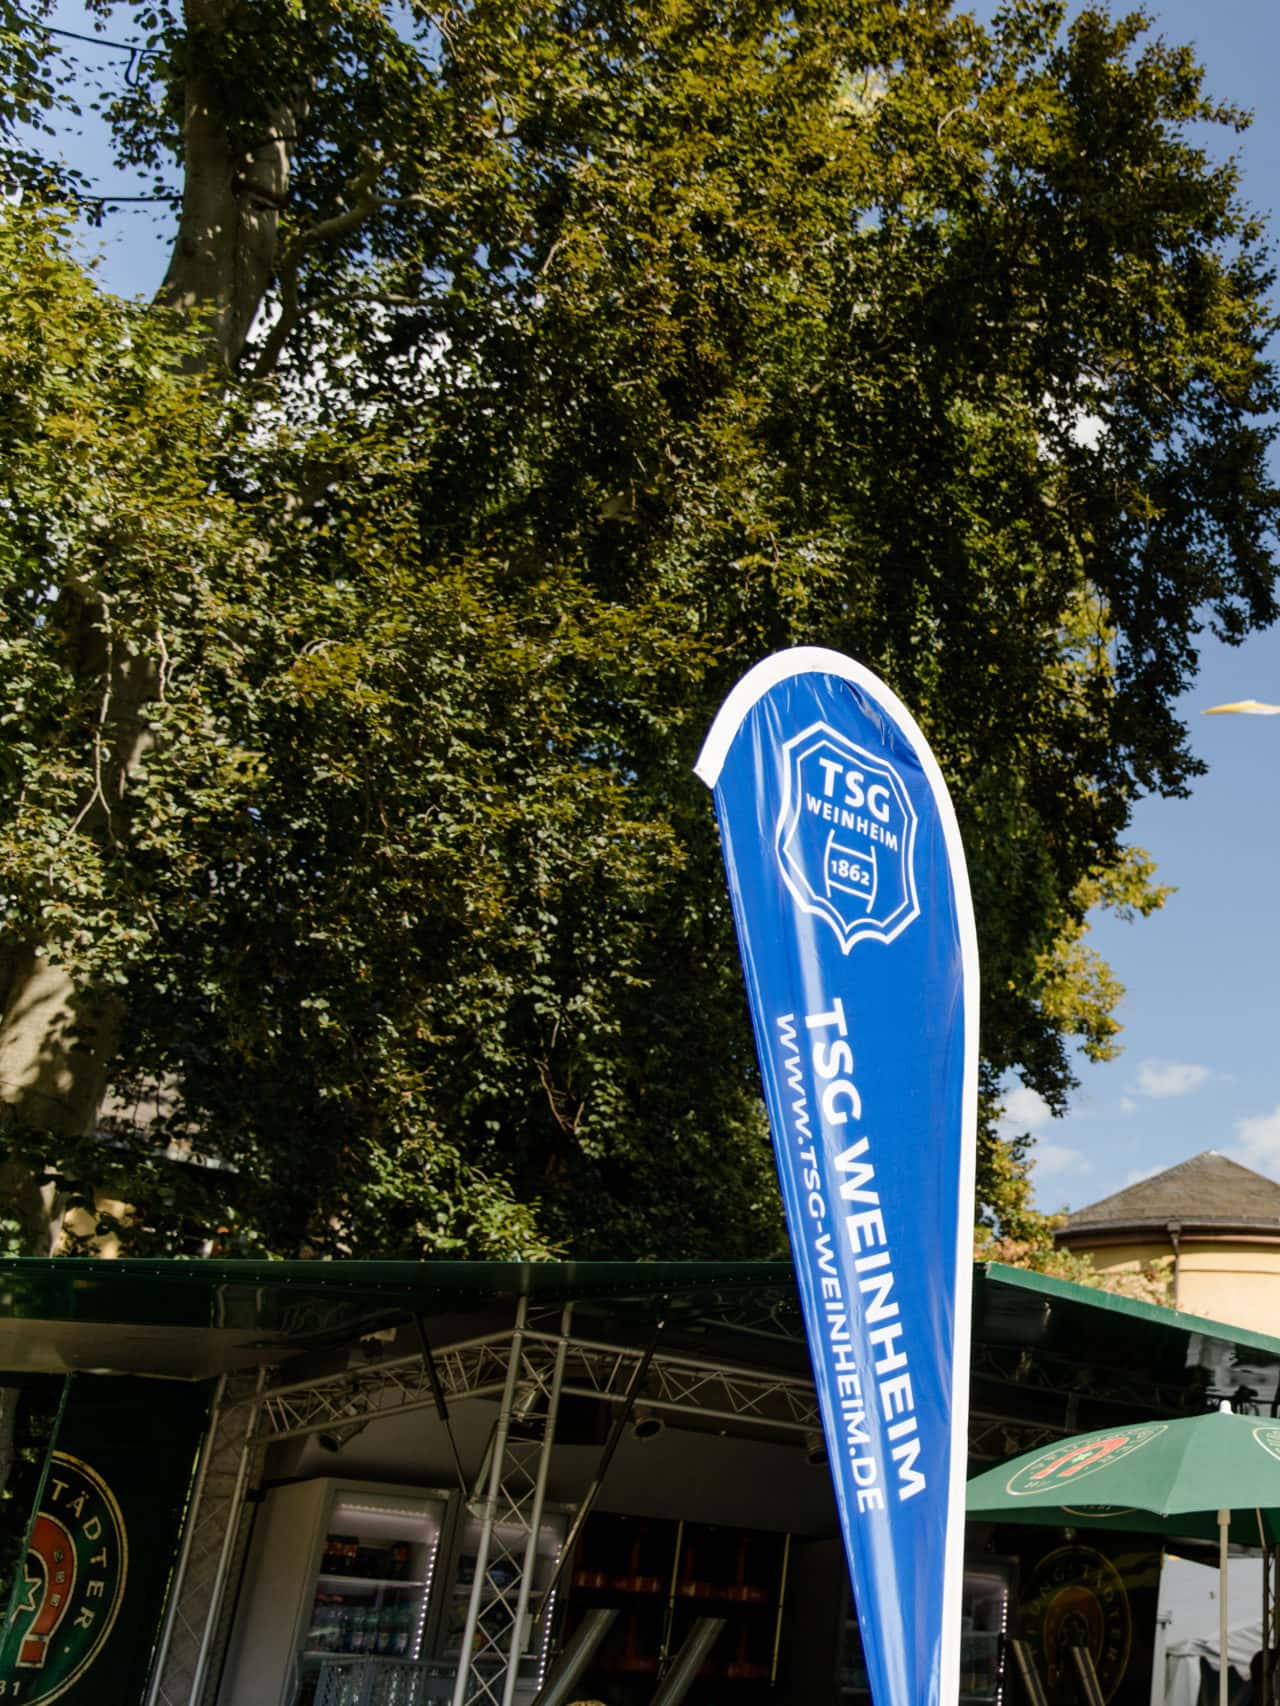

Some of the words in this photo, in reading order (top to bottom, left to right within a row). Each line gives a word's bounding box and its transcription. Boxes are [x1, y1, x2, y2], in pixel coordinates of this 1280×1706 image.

[806, 793, 898, 852] WEINHEIM
[819, 757, 890, 823] TSG
[831, 859, 870, 887] 1862
[777, 1014, 884, 1513] WWW.TSG-WEINHEIM.DE
[805, 998, 861, 1124] TSG
[834, 1137, 926, 1502] WEINHEIM
